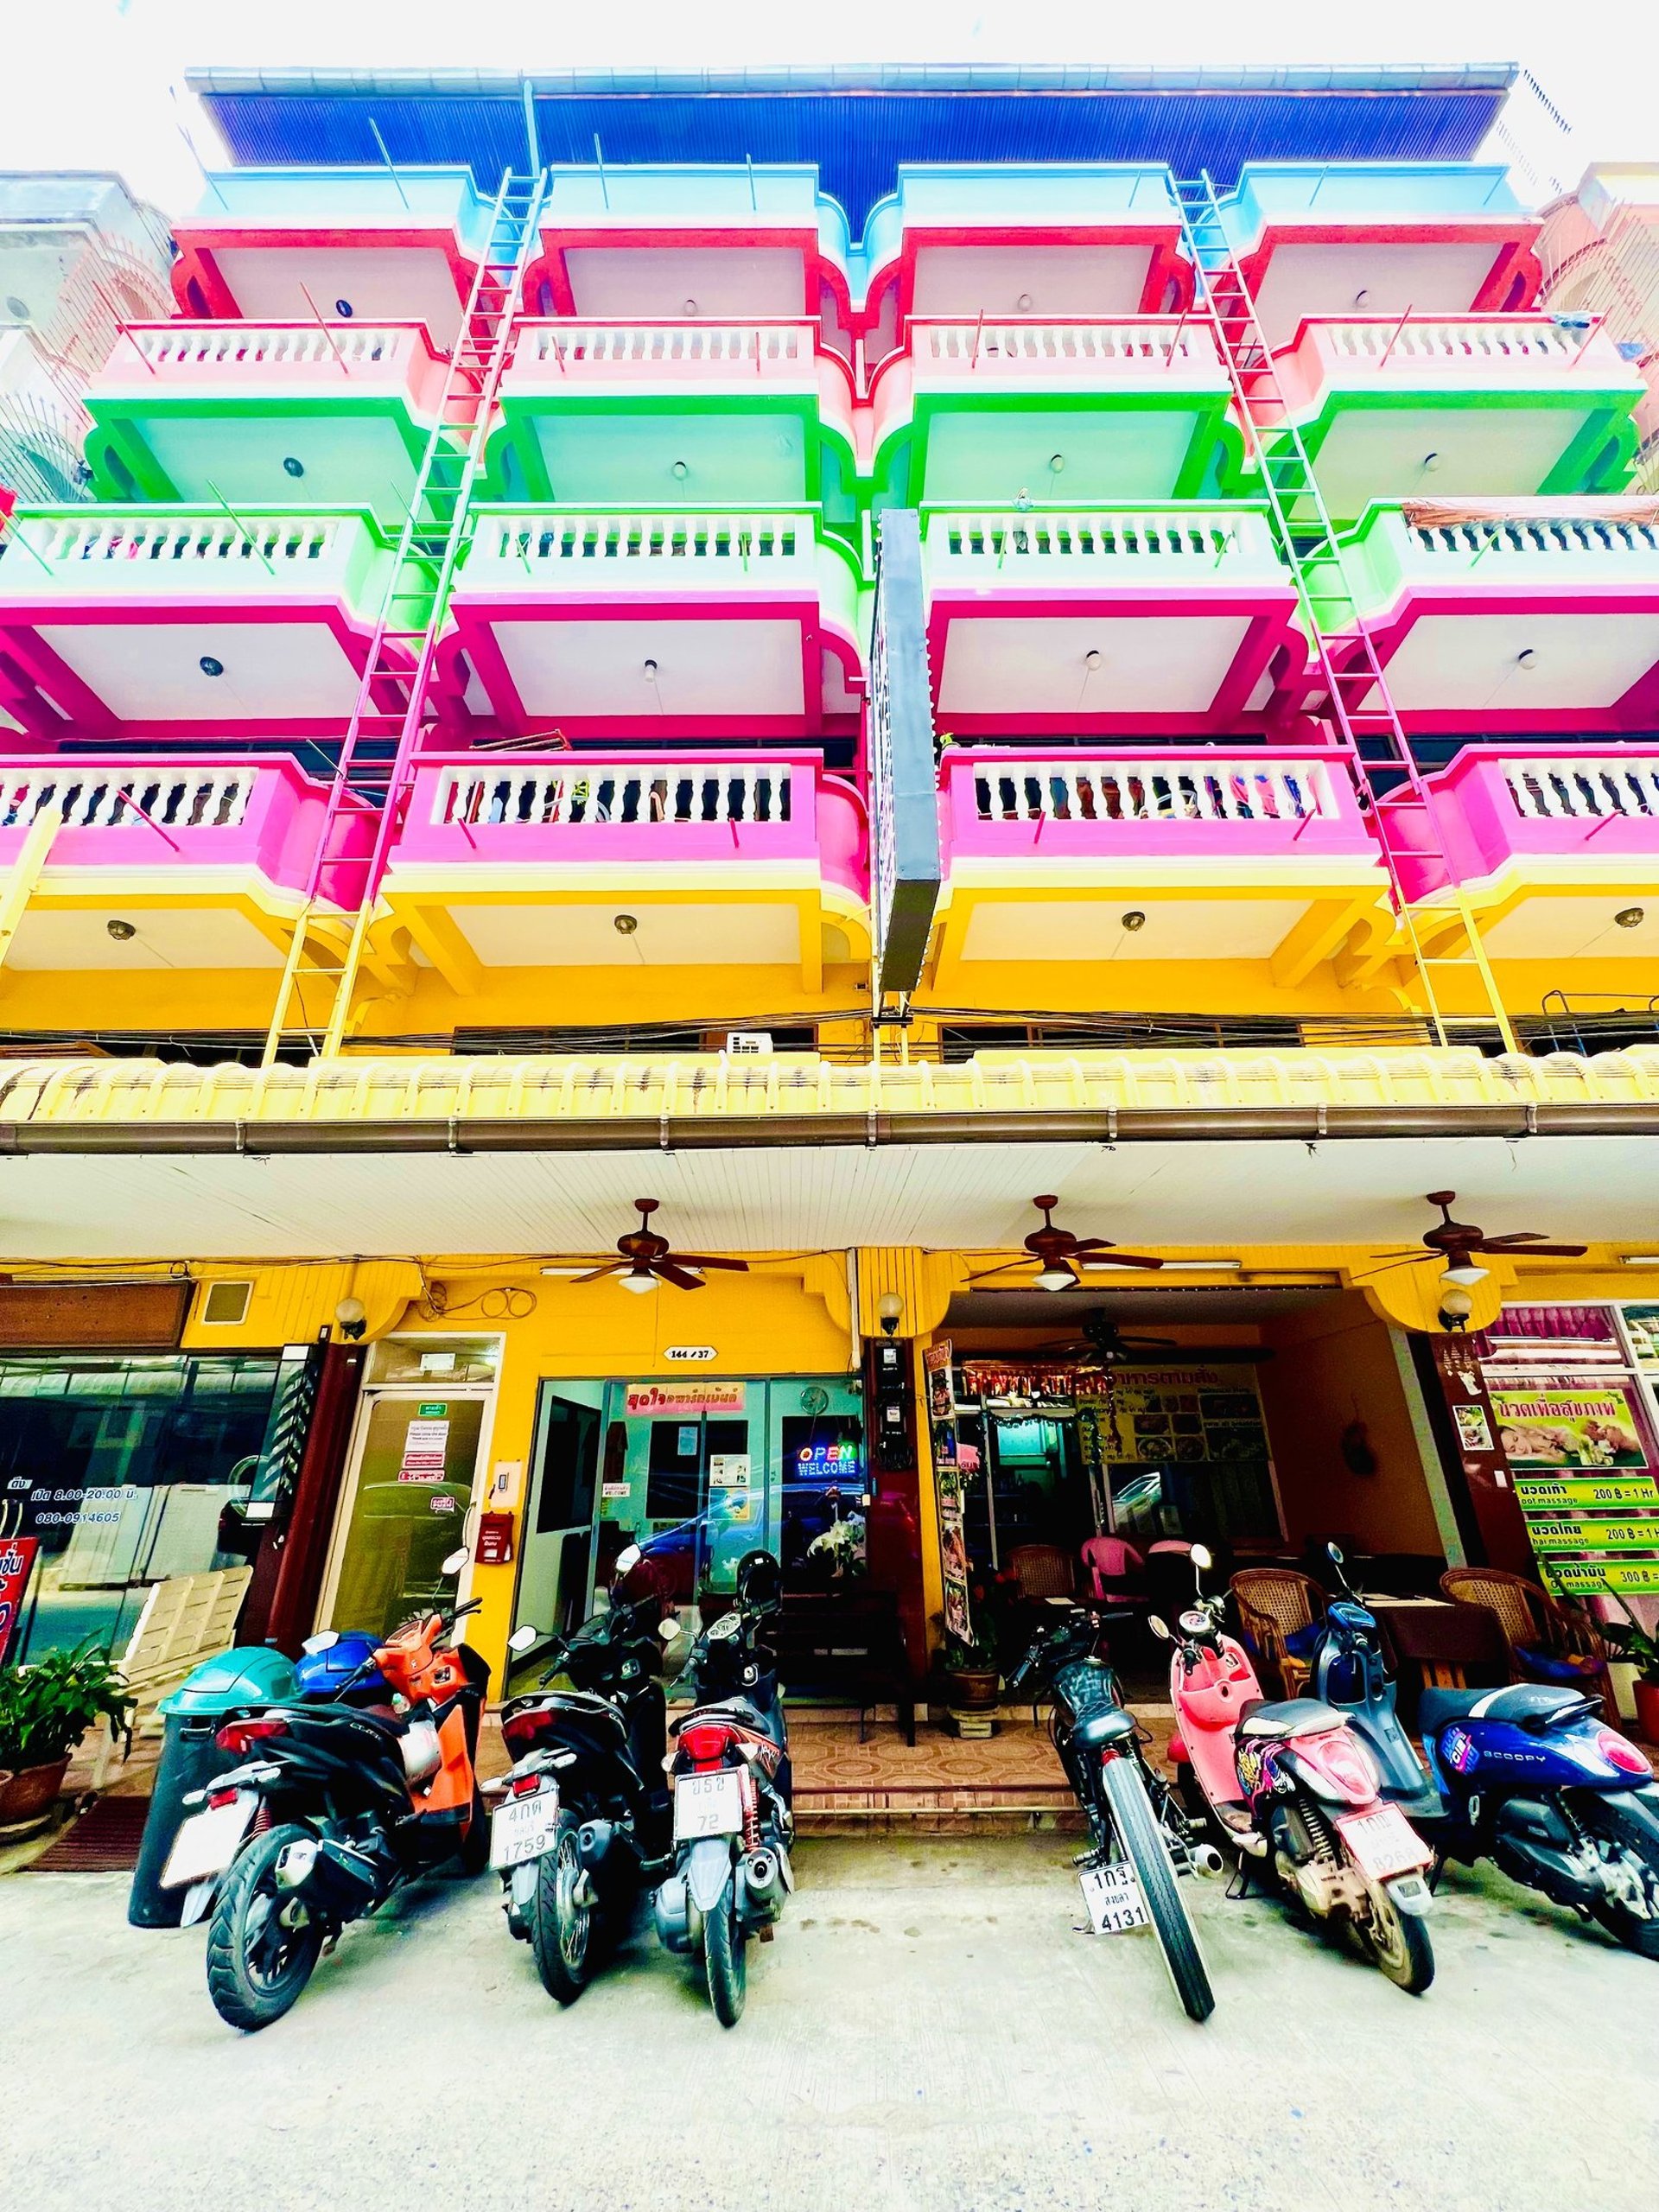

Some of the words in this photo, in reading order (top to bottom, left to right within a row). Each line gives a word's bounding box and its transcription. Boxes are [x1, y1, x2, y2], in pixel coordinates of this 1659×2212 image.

[1498, 1393, 1616, 1423] นวดเพื่อสุขภาพ
[799, 1445, 854, 1461] OPEN
[798, 1460, 855, 1476] WELCOME
[31, 1488, 51, 1501] เปิด
[54, 1489, 122, 1500] 8.00-20.00
[1521, 1483, 1567, 1495] นวดเท้า
[1593, 1488, 1612, 1499] 200
[1633, 1488, 1639, 1498] 1
[1642, 1488, 1654, 1498] Hr
[35, 1513, 120, 1524] 080-0914605
[1531, 1522, 1582, 1535] นวดไทย
[1606, 1529, 1625, 1540] 200
[1646, 1529, 1652, 1539] 1
[1620, 1571, 1640, 1582] 300
[1483, 1750, 1547, 1763] SCOOPY
[697, 1814, 719, 1831] 72
[504, 1834, 546, 1861] 1759
[1102, 1906, 1145, 1931] 4131
